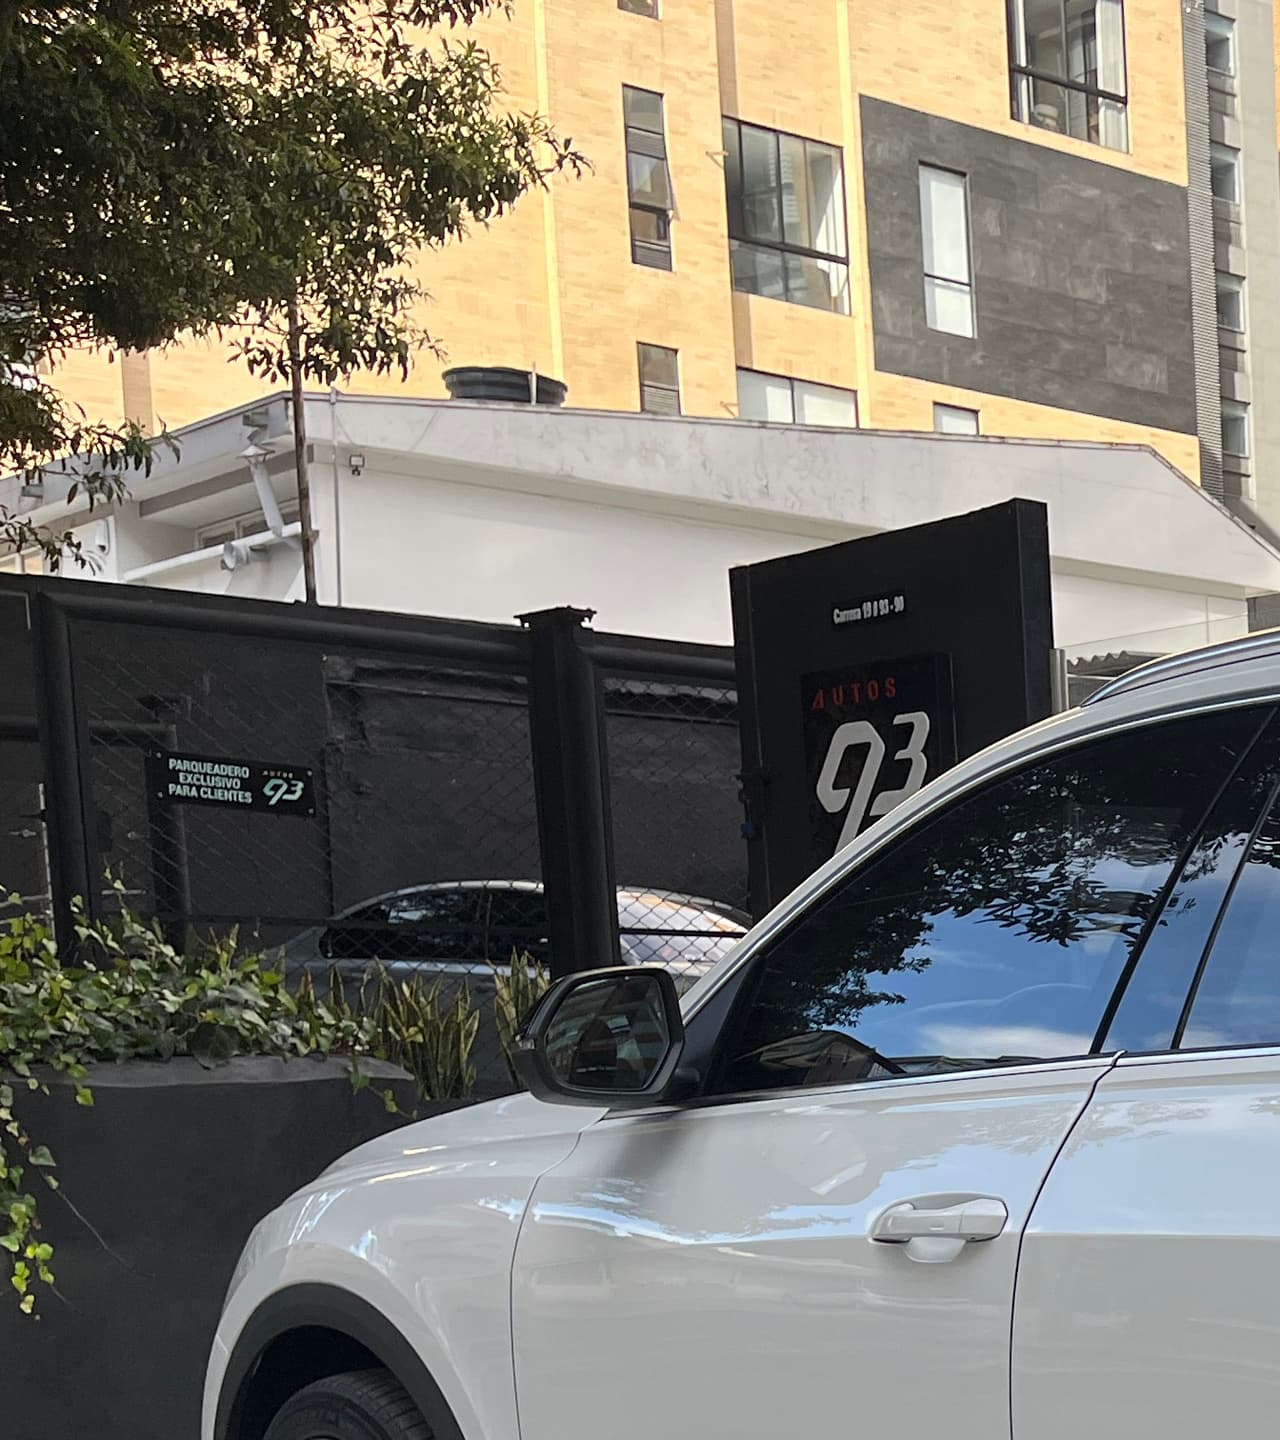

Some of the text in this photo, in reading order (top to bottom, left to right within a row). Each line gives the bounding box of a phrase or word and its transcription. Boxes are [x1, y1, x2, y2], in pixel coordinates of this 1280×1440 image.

[812, 677, 896, 710] AUTOS
[168, 758, 250, 779] PARQUEADERO
[179, 772, 241, 789] EXCLUSIVO
[168, 783, 252, 804] PARA CLIENTES
[262, 778, 304, 805] 93
[816, 711, 930, 856] 93
